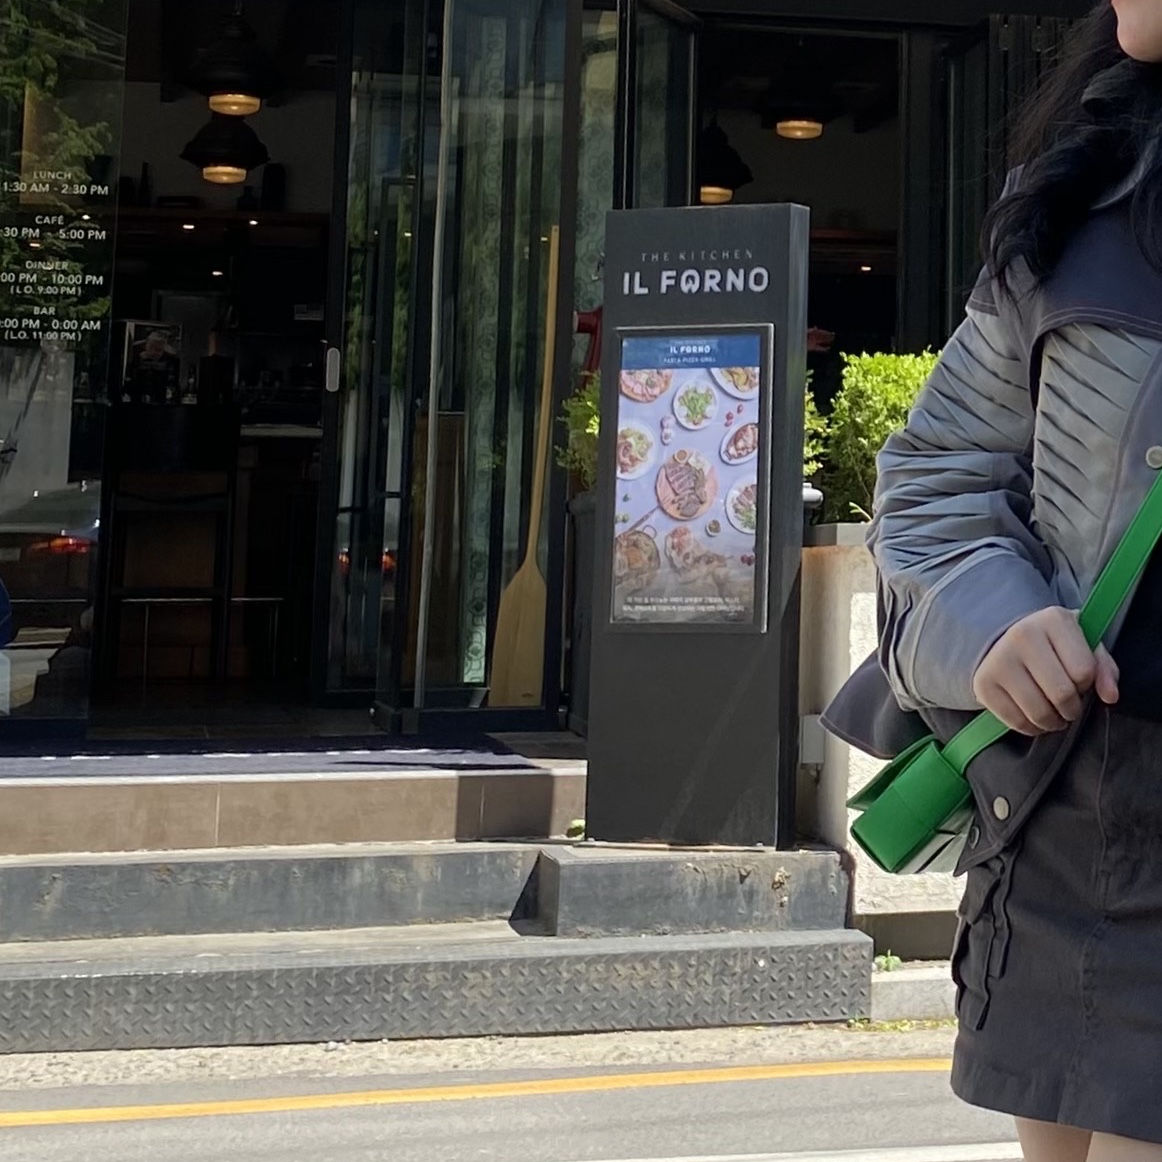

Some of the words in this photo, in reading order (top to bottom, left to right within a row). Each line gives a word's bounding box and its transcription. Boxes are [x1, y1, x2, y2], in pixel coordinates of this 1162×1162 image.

[33, 171, 72, 180] LUNCH
[29, 183, 50, 193] AM
[61, 184, 88, 195] 2:30
[90, 185, 109, 196] PM
[35, 215, 65, 225] CAFÉ
[21, 228, 40, 239] PM
[59, 229, 85, 240] 5:00
[88, 230, 106, 240] PM
[641, 252, 670, 262] THE
[679, 249, 753, 261] KITCHEN
[25, 260, 69, 271] DINNER
[18, 273, 37, 284] PM
[52, 274, 82, 285] 10:00
[85, 275, 104, 285] PM
[623, 271, 649, 295] IL
[660, 266, 769, 294] FORNO
[33, 306, 56, 316] BAR
[22, 319, 40, 330] PM
[51, 319, 78, 330] 0:00
[81, 320, 101, 331] AM
[32, 331, 59, 340] 11:00
[670, 345, 678, 354] IL
